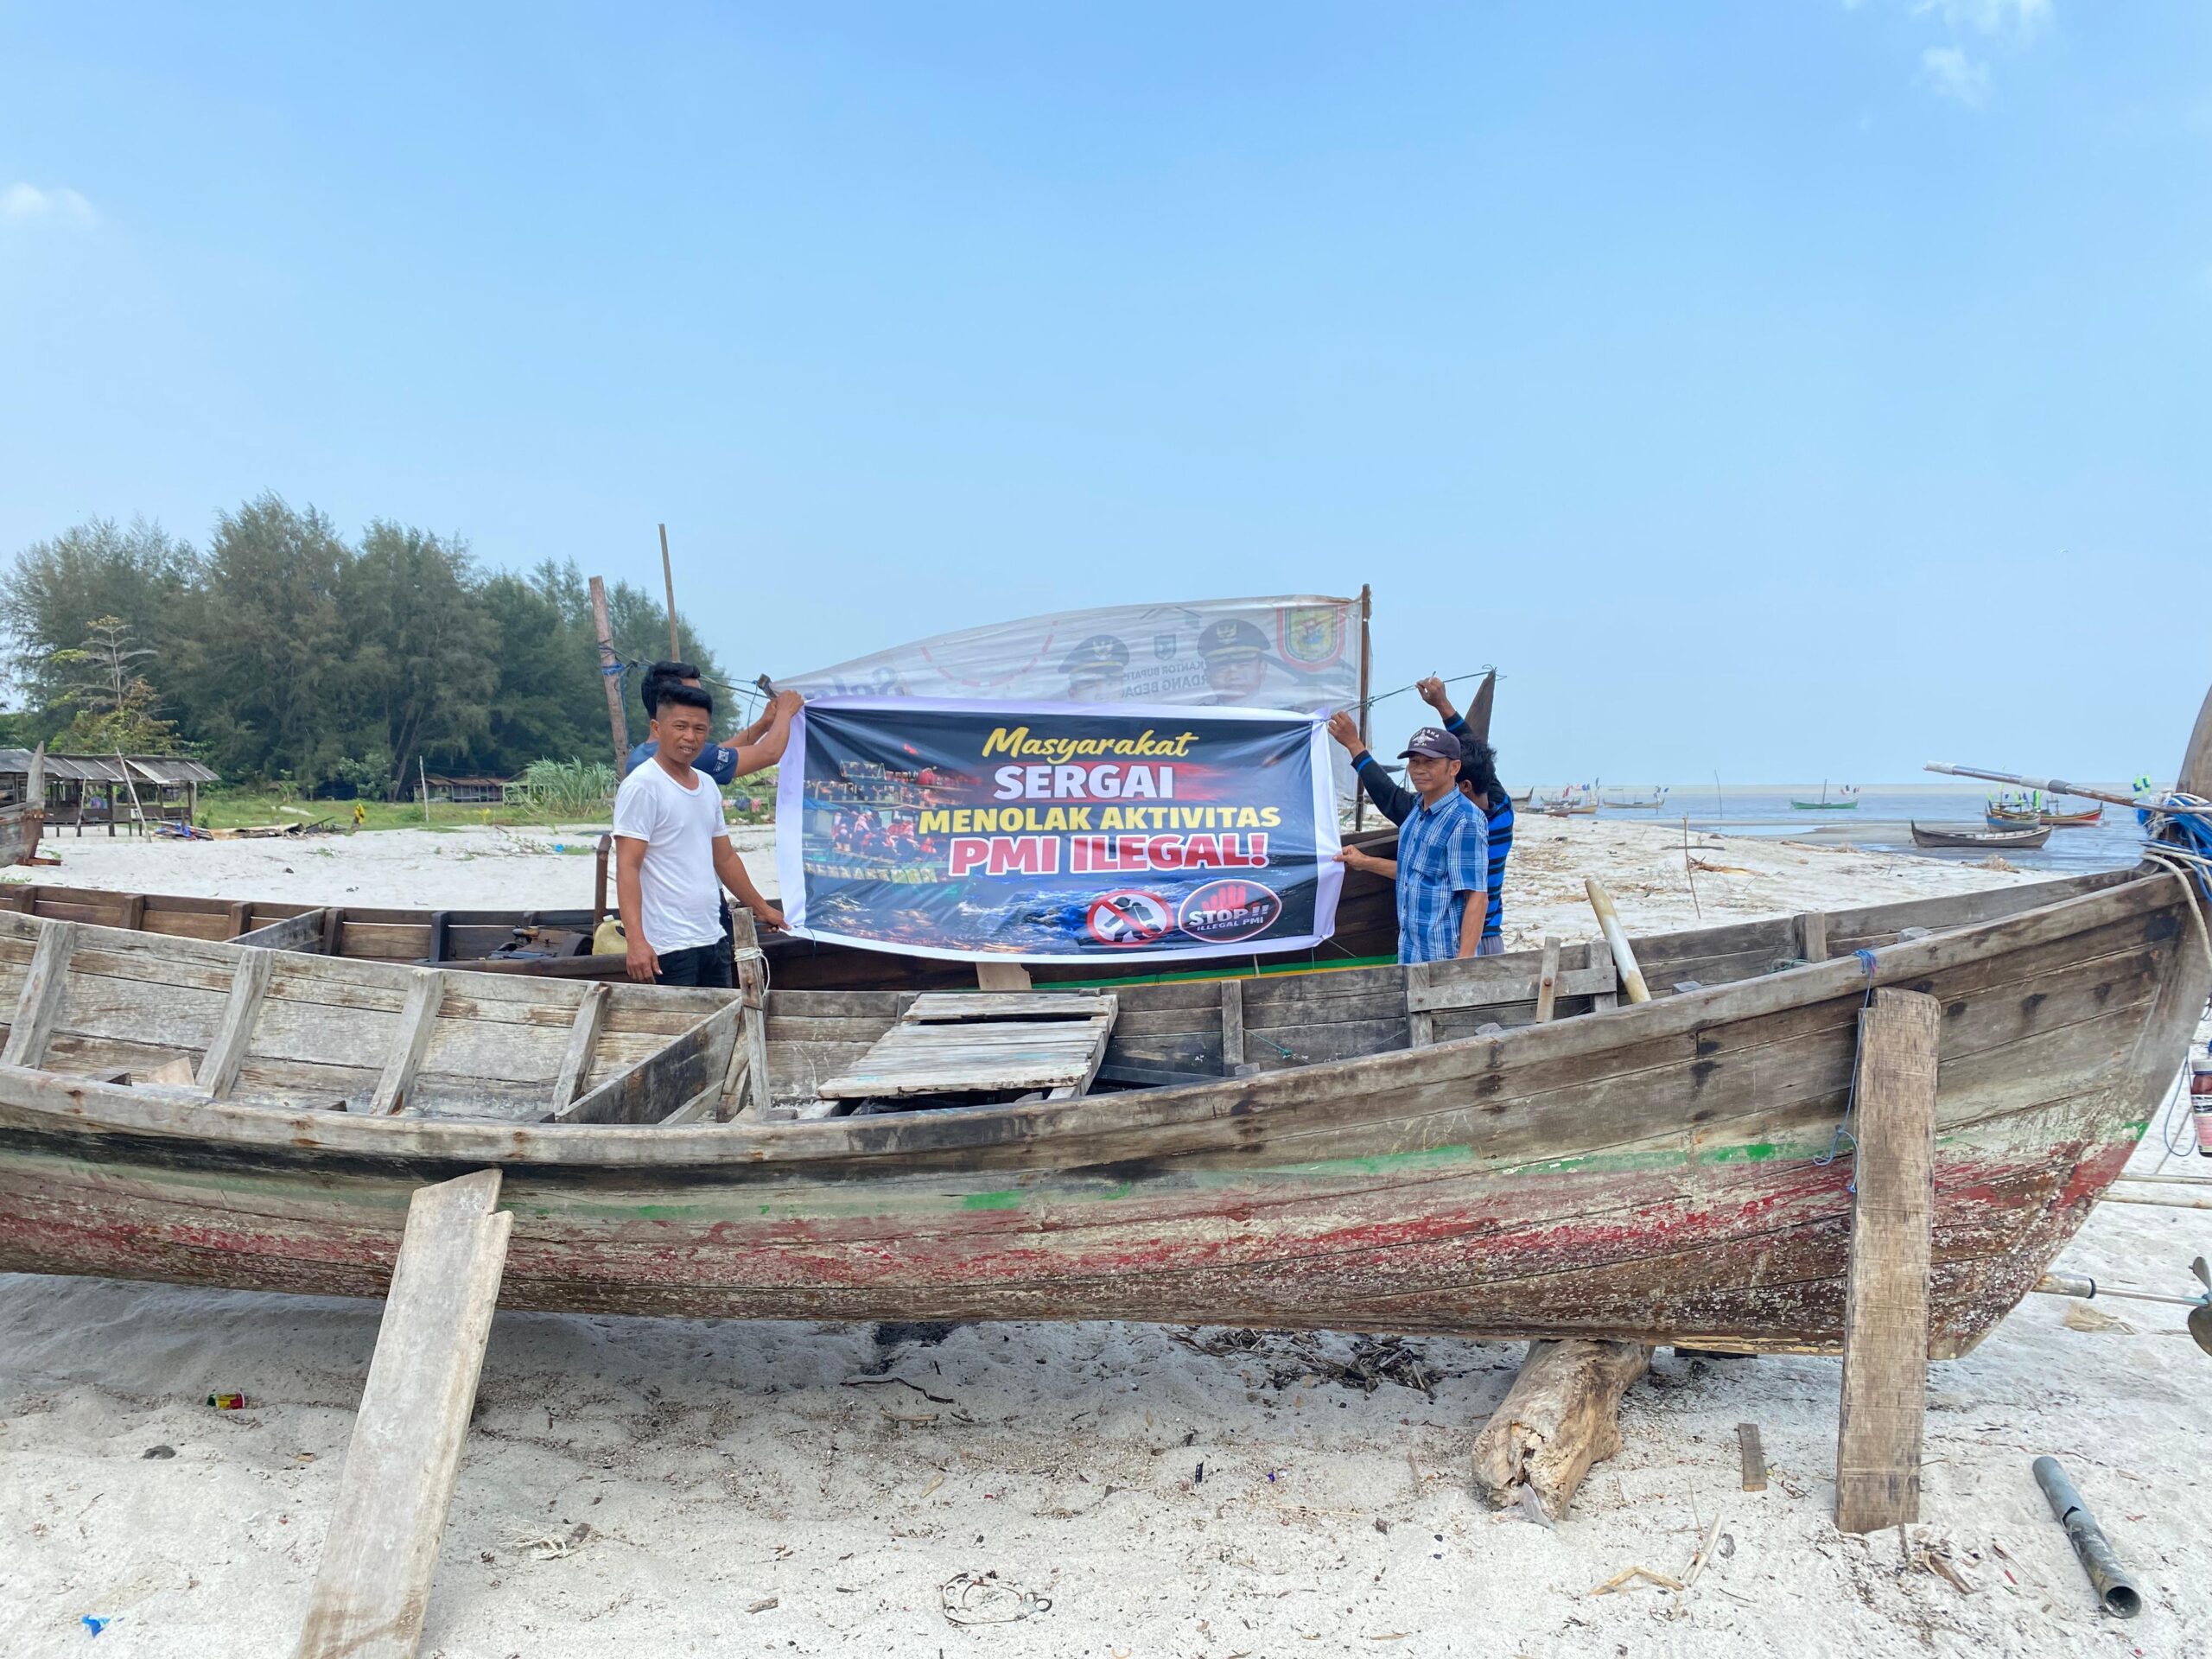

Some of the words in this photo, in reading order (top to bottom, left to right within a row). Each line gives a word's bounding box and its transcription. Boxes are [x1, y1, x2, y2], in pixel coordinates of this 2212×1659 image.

[982, 727, 1199, 765] Masyarakat
[993, 765, 1174, 800] SERGAI
[918, 807, 1095, 834] MENOLAK
[1099, 806, 1282, 830] AKTIVITAS
[949, 835, 1061, 876] PMI
[1069, 832, 1270, 874] ILEGAL!
[1189, 908, 1249, 926] STOP
[1197, 922, 1240, 931] ILLEGAL
[1243, 916, 1264, 925] PMI
